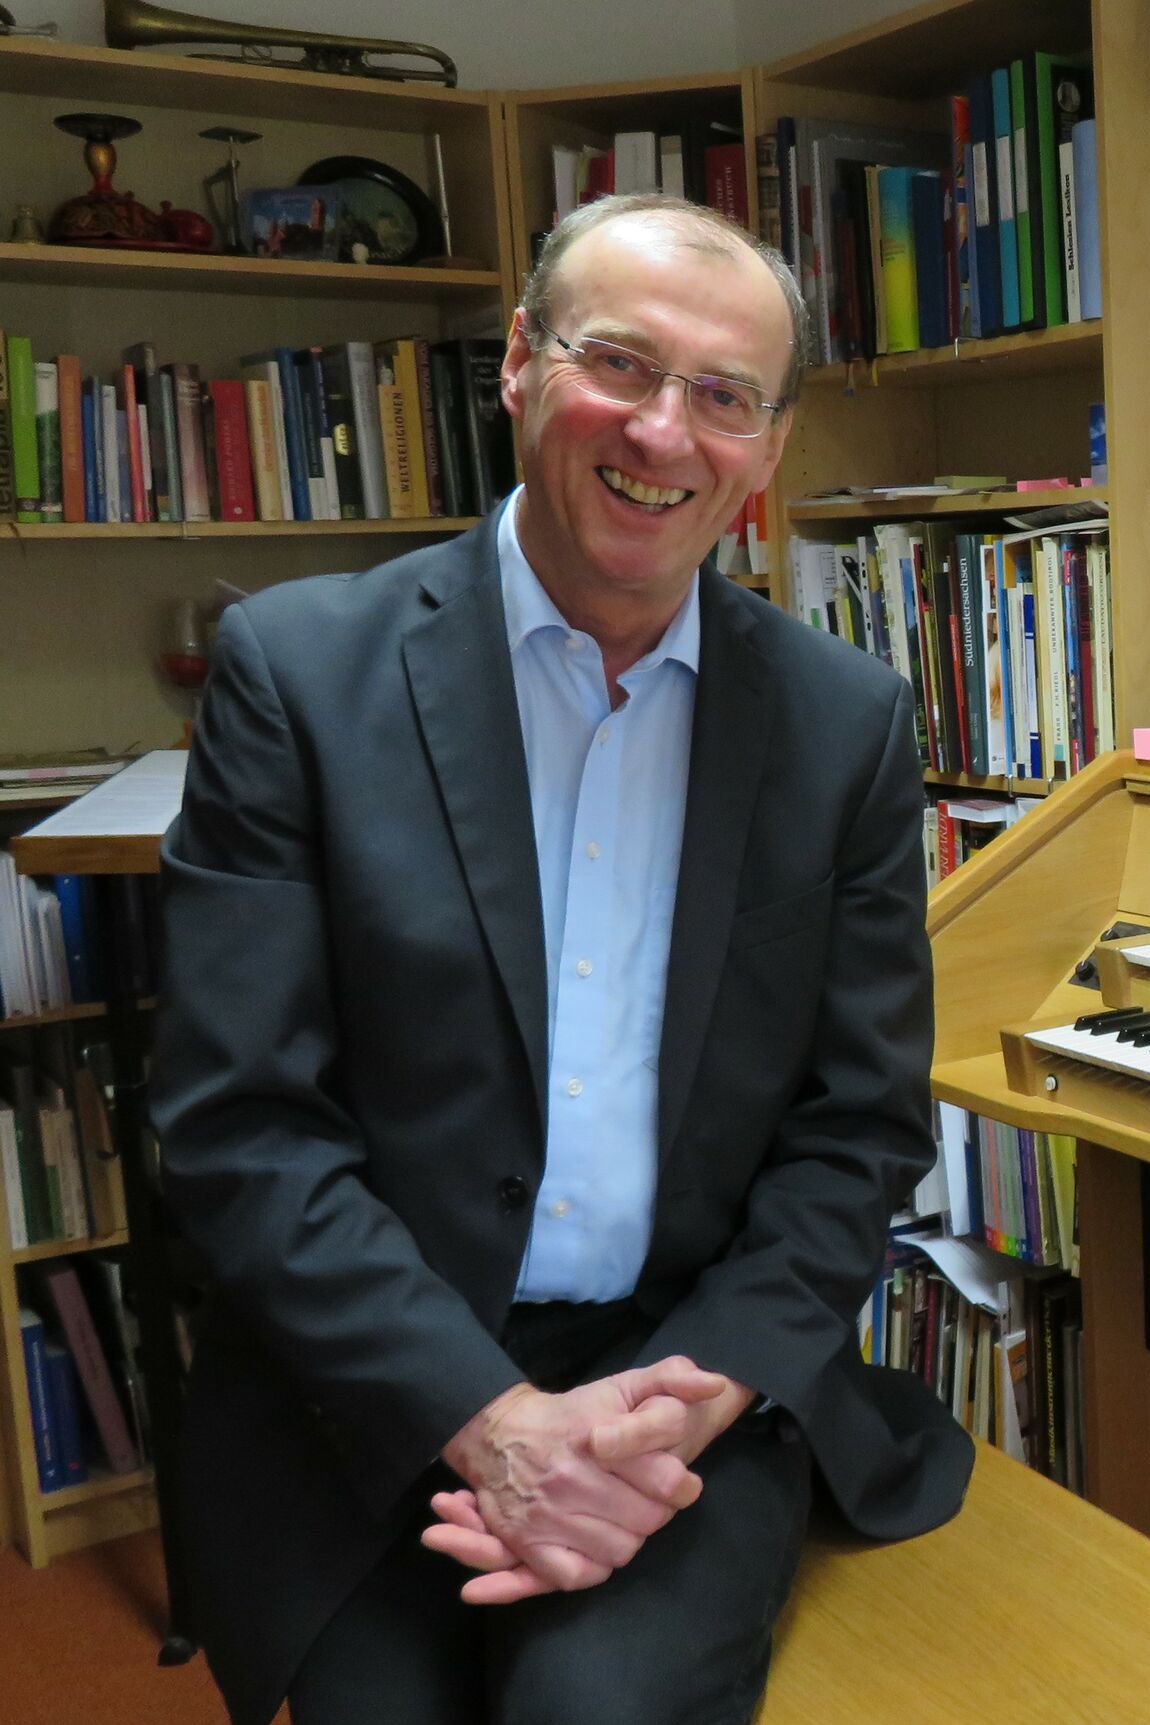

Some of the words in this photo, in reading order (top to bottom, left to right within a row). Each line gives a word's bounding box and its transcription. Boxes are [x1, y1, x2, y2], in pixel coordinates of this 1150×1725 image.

[1063, 174, 1073, 217] Lexikon
[1066, 219, 1075, 271] Schlesien
[392, 391, 411, 493] WELTRELIGIONEN
[958, 557, 975, 667] Südniedersachsen
